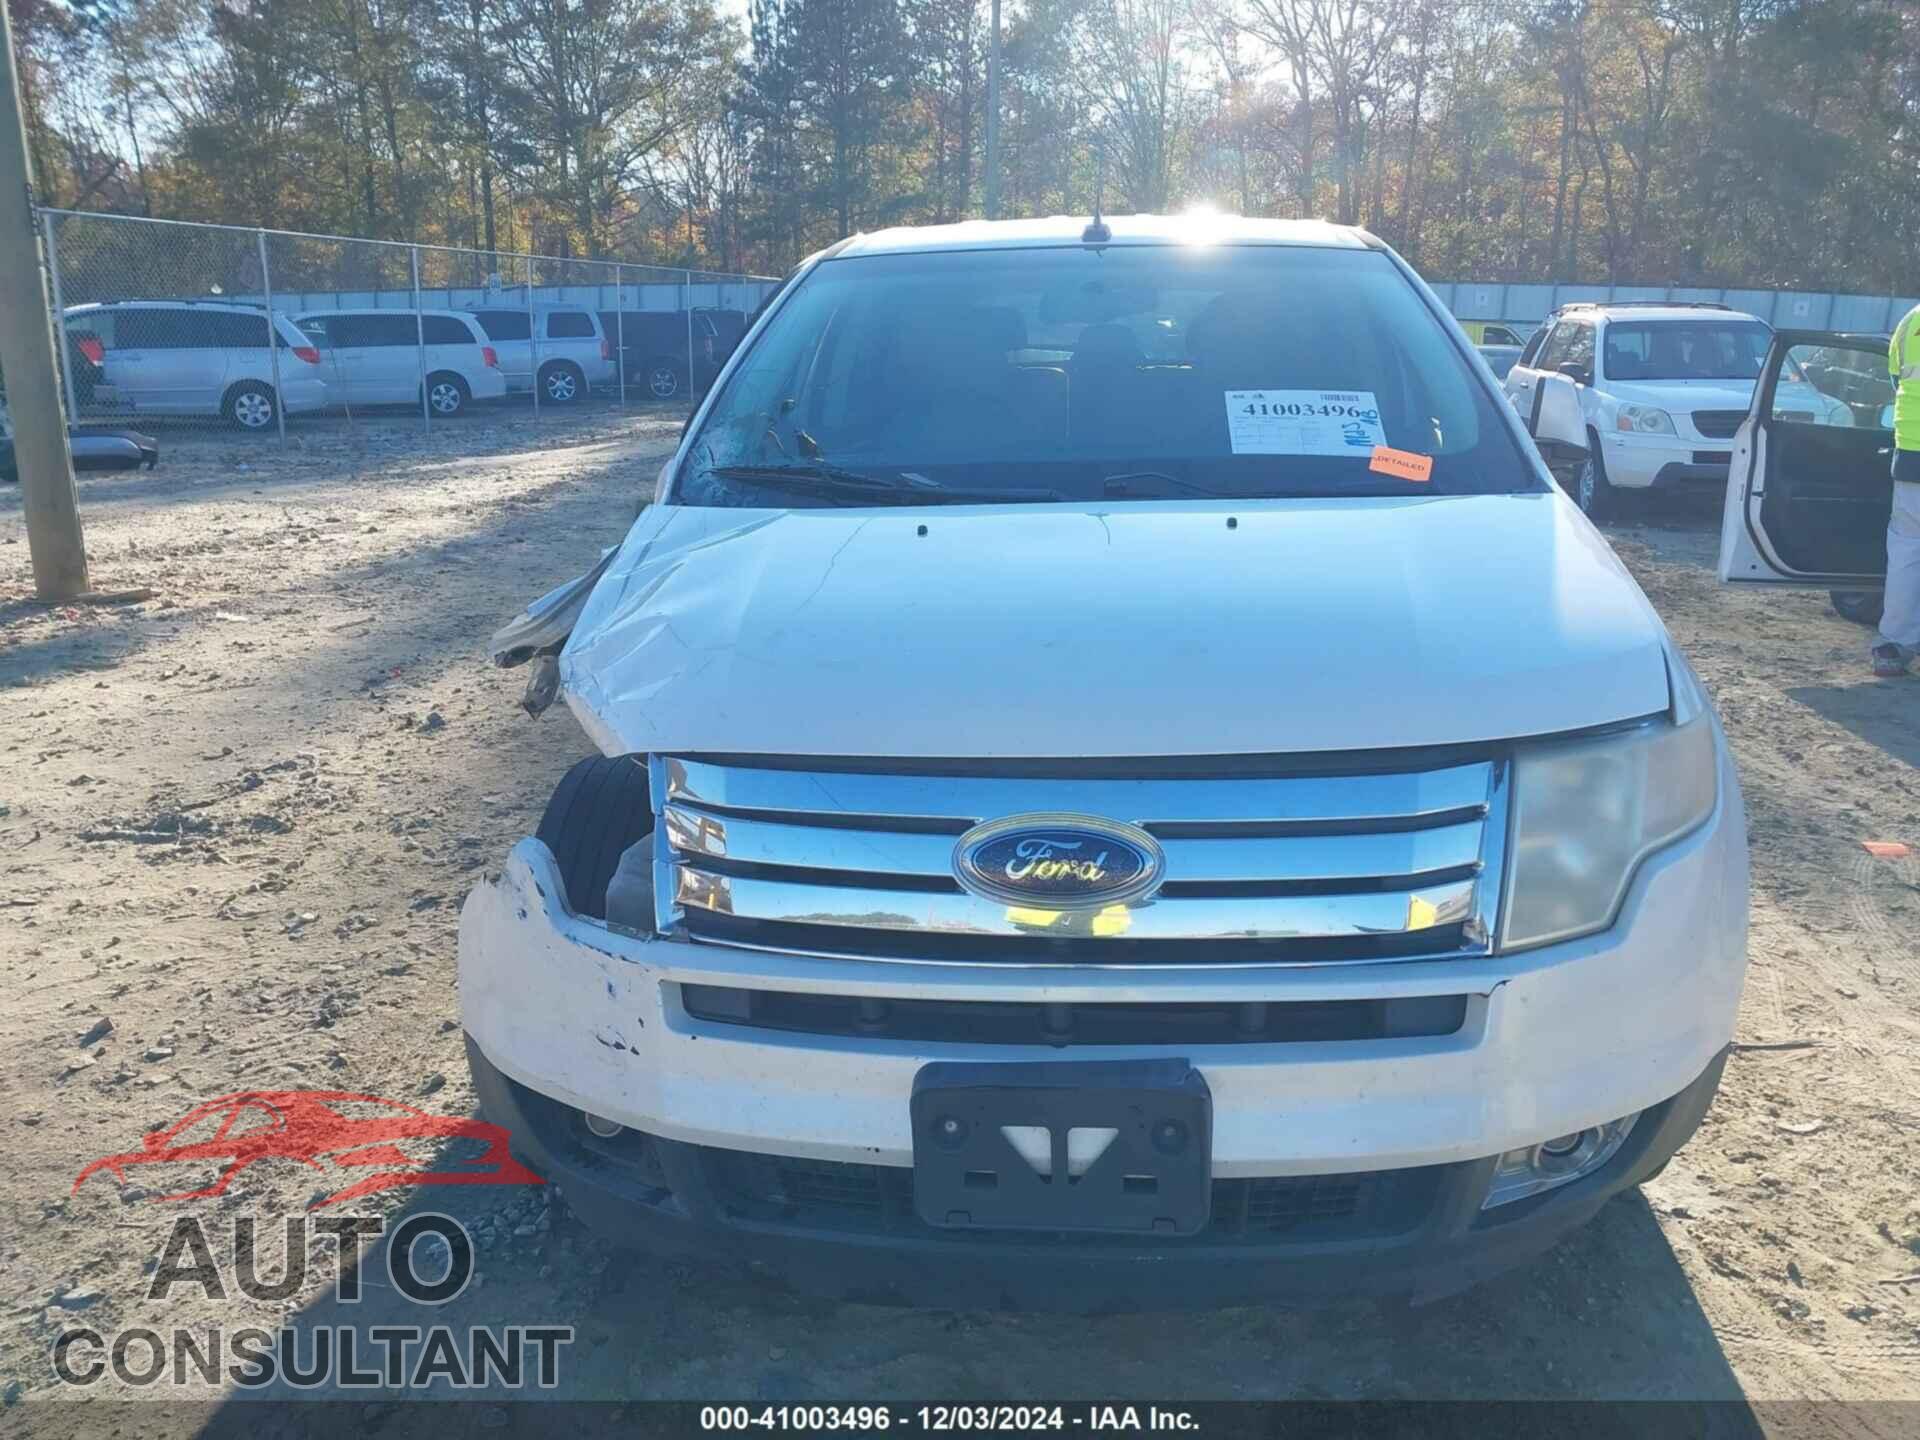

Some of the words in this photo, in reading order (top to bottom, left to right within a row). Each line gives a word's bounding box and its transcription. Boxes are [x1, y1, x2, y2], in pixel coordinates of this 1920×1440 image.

[1242, 403, 1361, 418] 41003496
[1376, 454, 1425, 472] DETAILED
[1005, 838, 1108, 882] Ford
